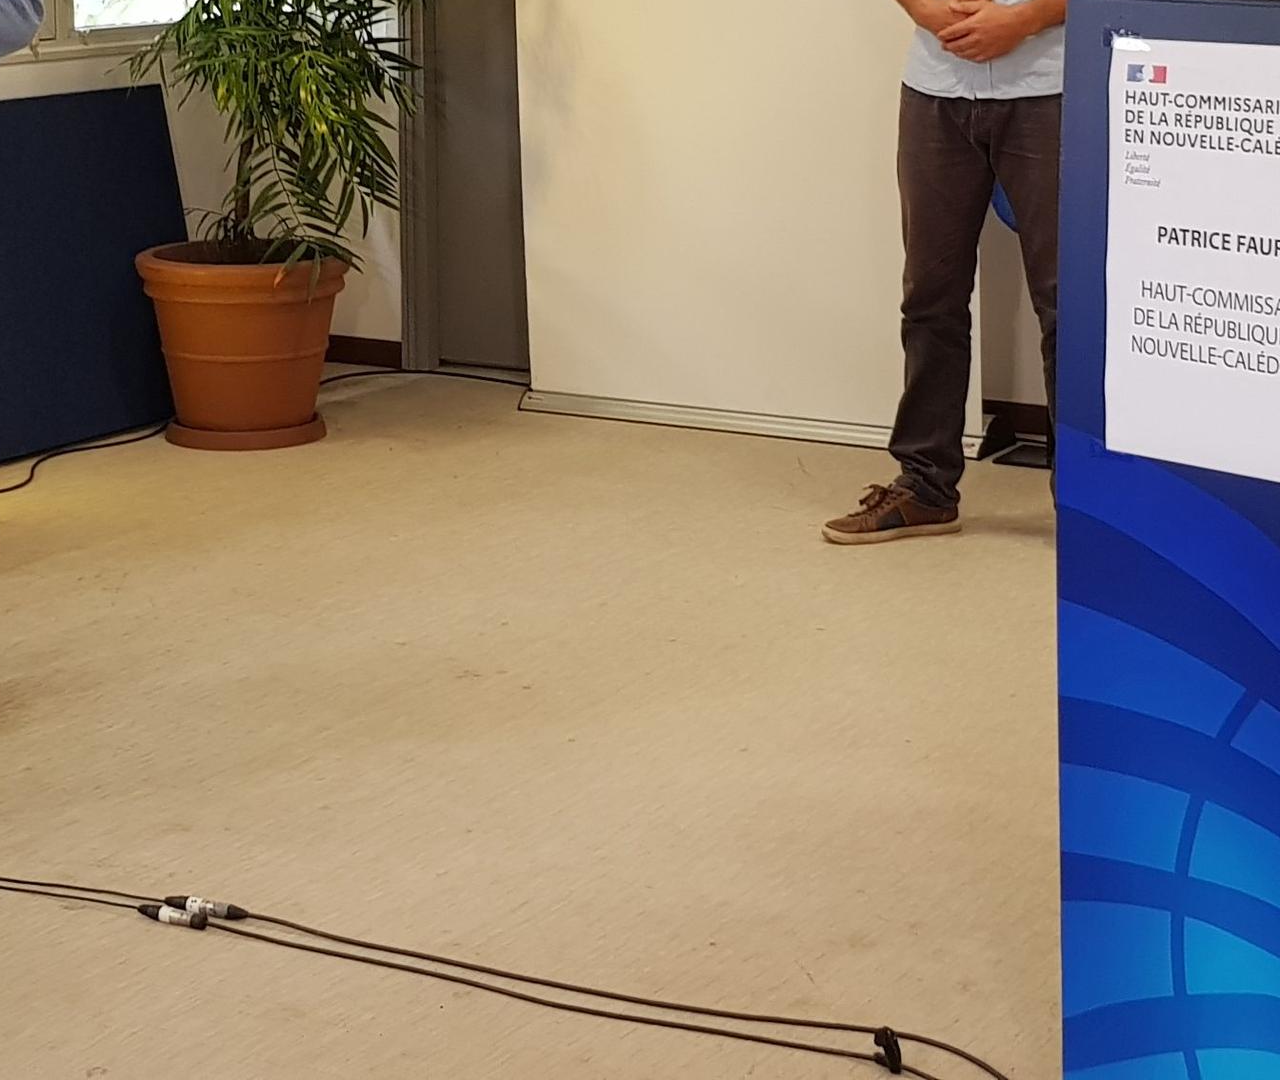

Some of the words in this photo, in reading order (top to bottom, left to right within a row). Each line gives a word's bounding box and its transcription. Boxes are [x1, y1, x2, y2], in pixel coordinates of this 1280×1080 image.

[1125, 110, 1144, 124] DE
[1150, 112, 1168, 126] LA
[1174, 111, 1274, 135] RÉPUBLIQUE
[1125, 129, 1144, 144] EN
[1158, 226, 1230, 251] PATRICE
[1134, 308, 1155, 327] DE
[1159, 311, 1179, 331] LA
